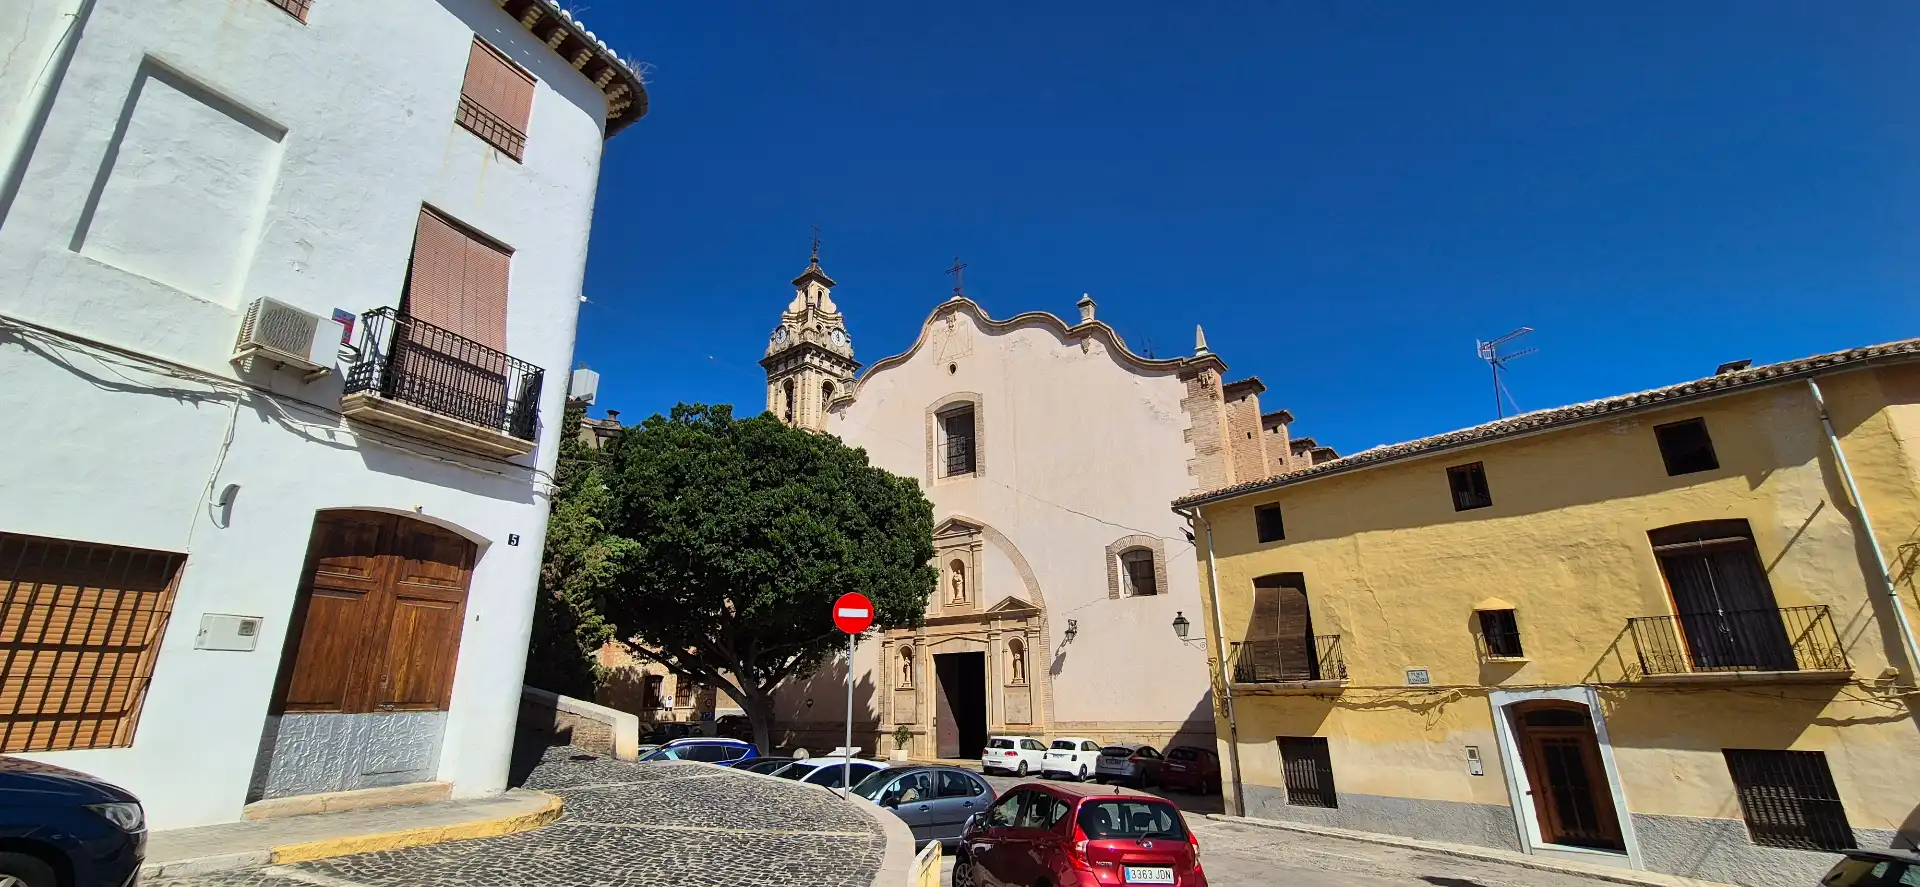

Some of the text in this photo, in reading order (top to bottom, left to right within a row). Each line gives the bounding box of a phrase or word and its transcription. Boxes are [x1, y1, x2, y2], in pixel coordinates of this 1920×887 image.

[510, 534, 518, 545] 5
[1131, 869, 1171, 880] 3363 JDN
